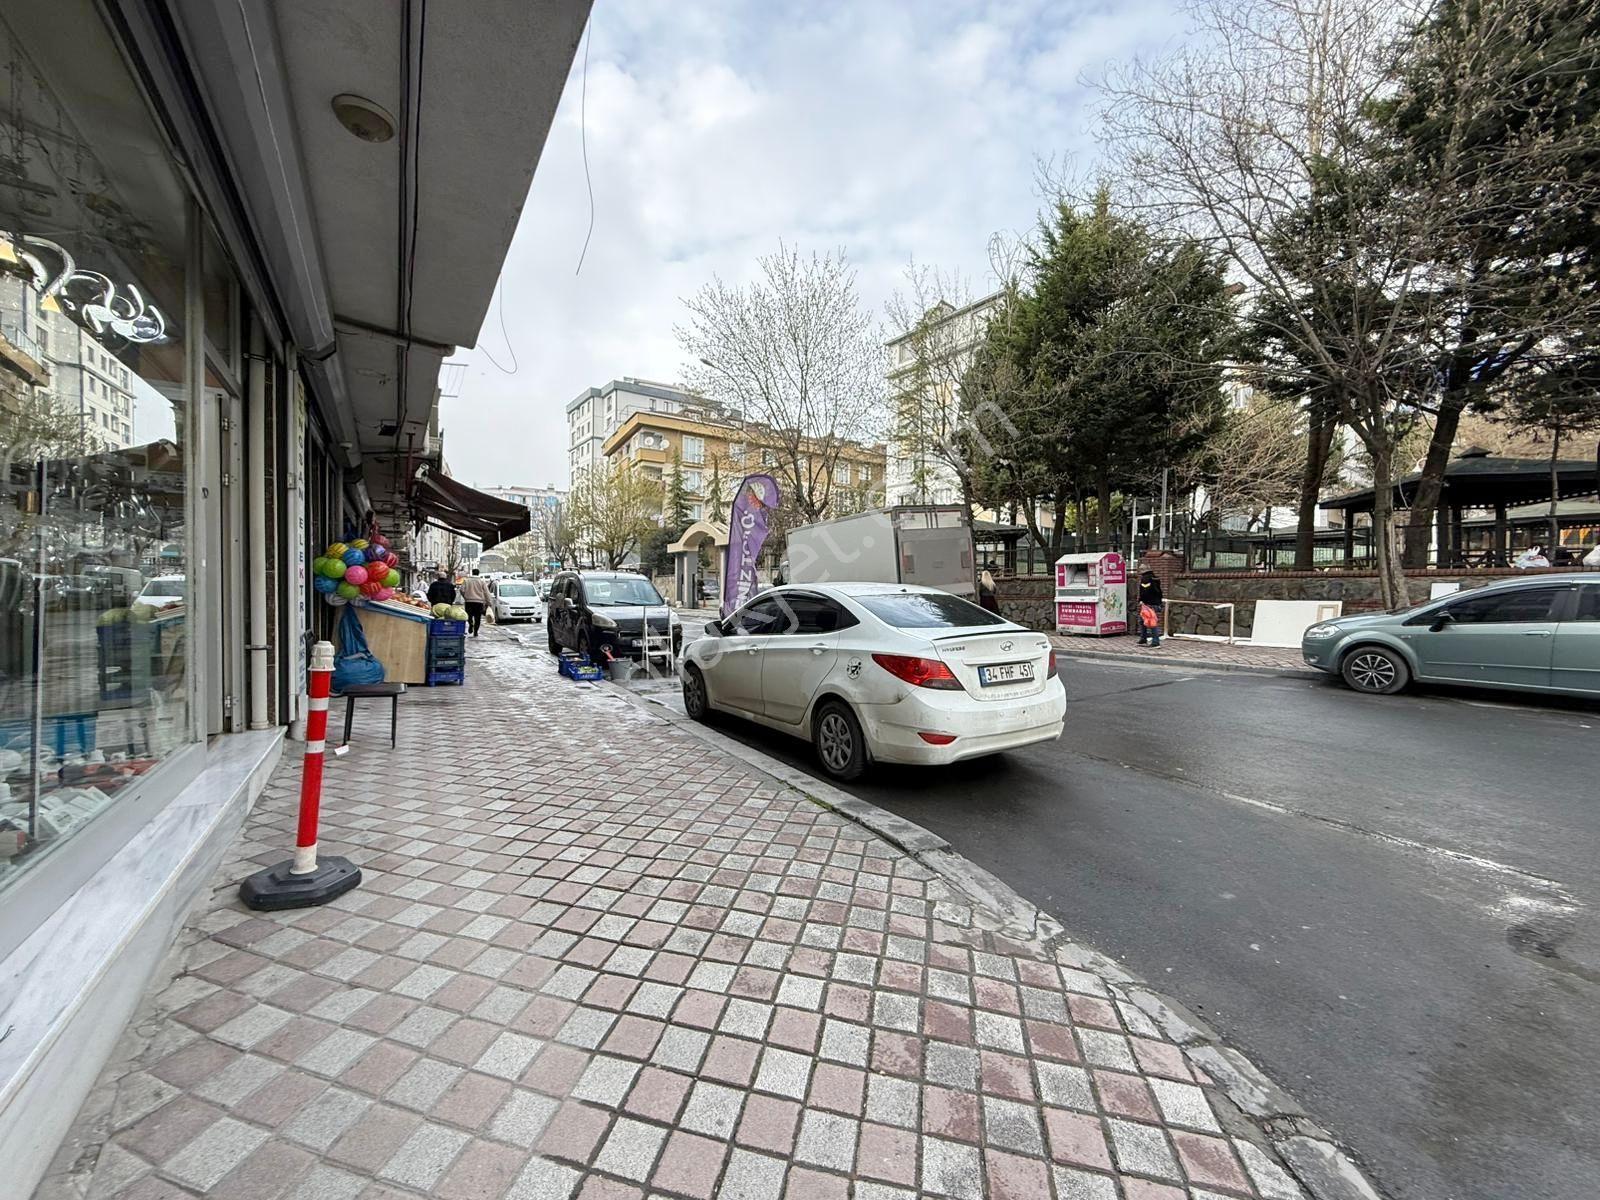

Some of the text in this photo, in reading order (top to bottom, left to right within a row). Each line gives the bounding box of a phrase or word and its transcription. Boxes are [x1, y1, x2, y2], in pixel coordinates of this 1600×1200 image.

[986, 664, 1032, 681] 34 FHF 451
